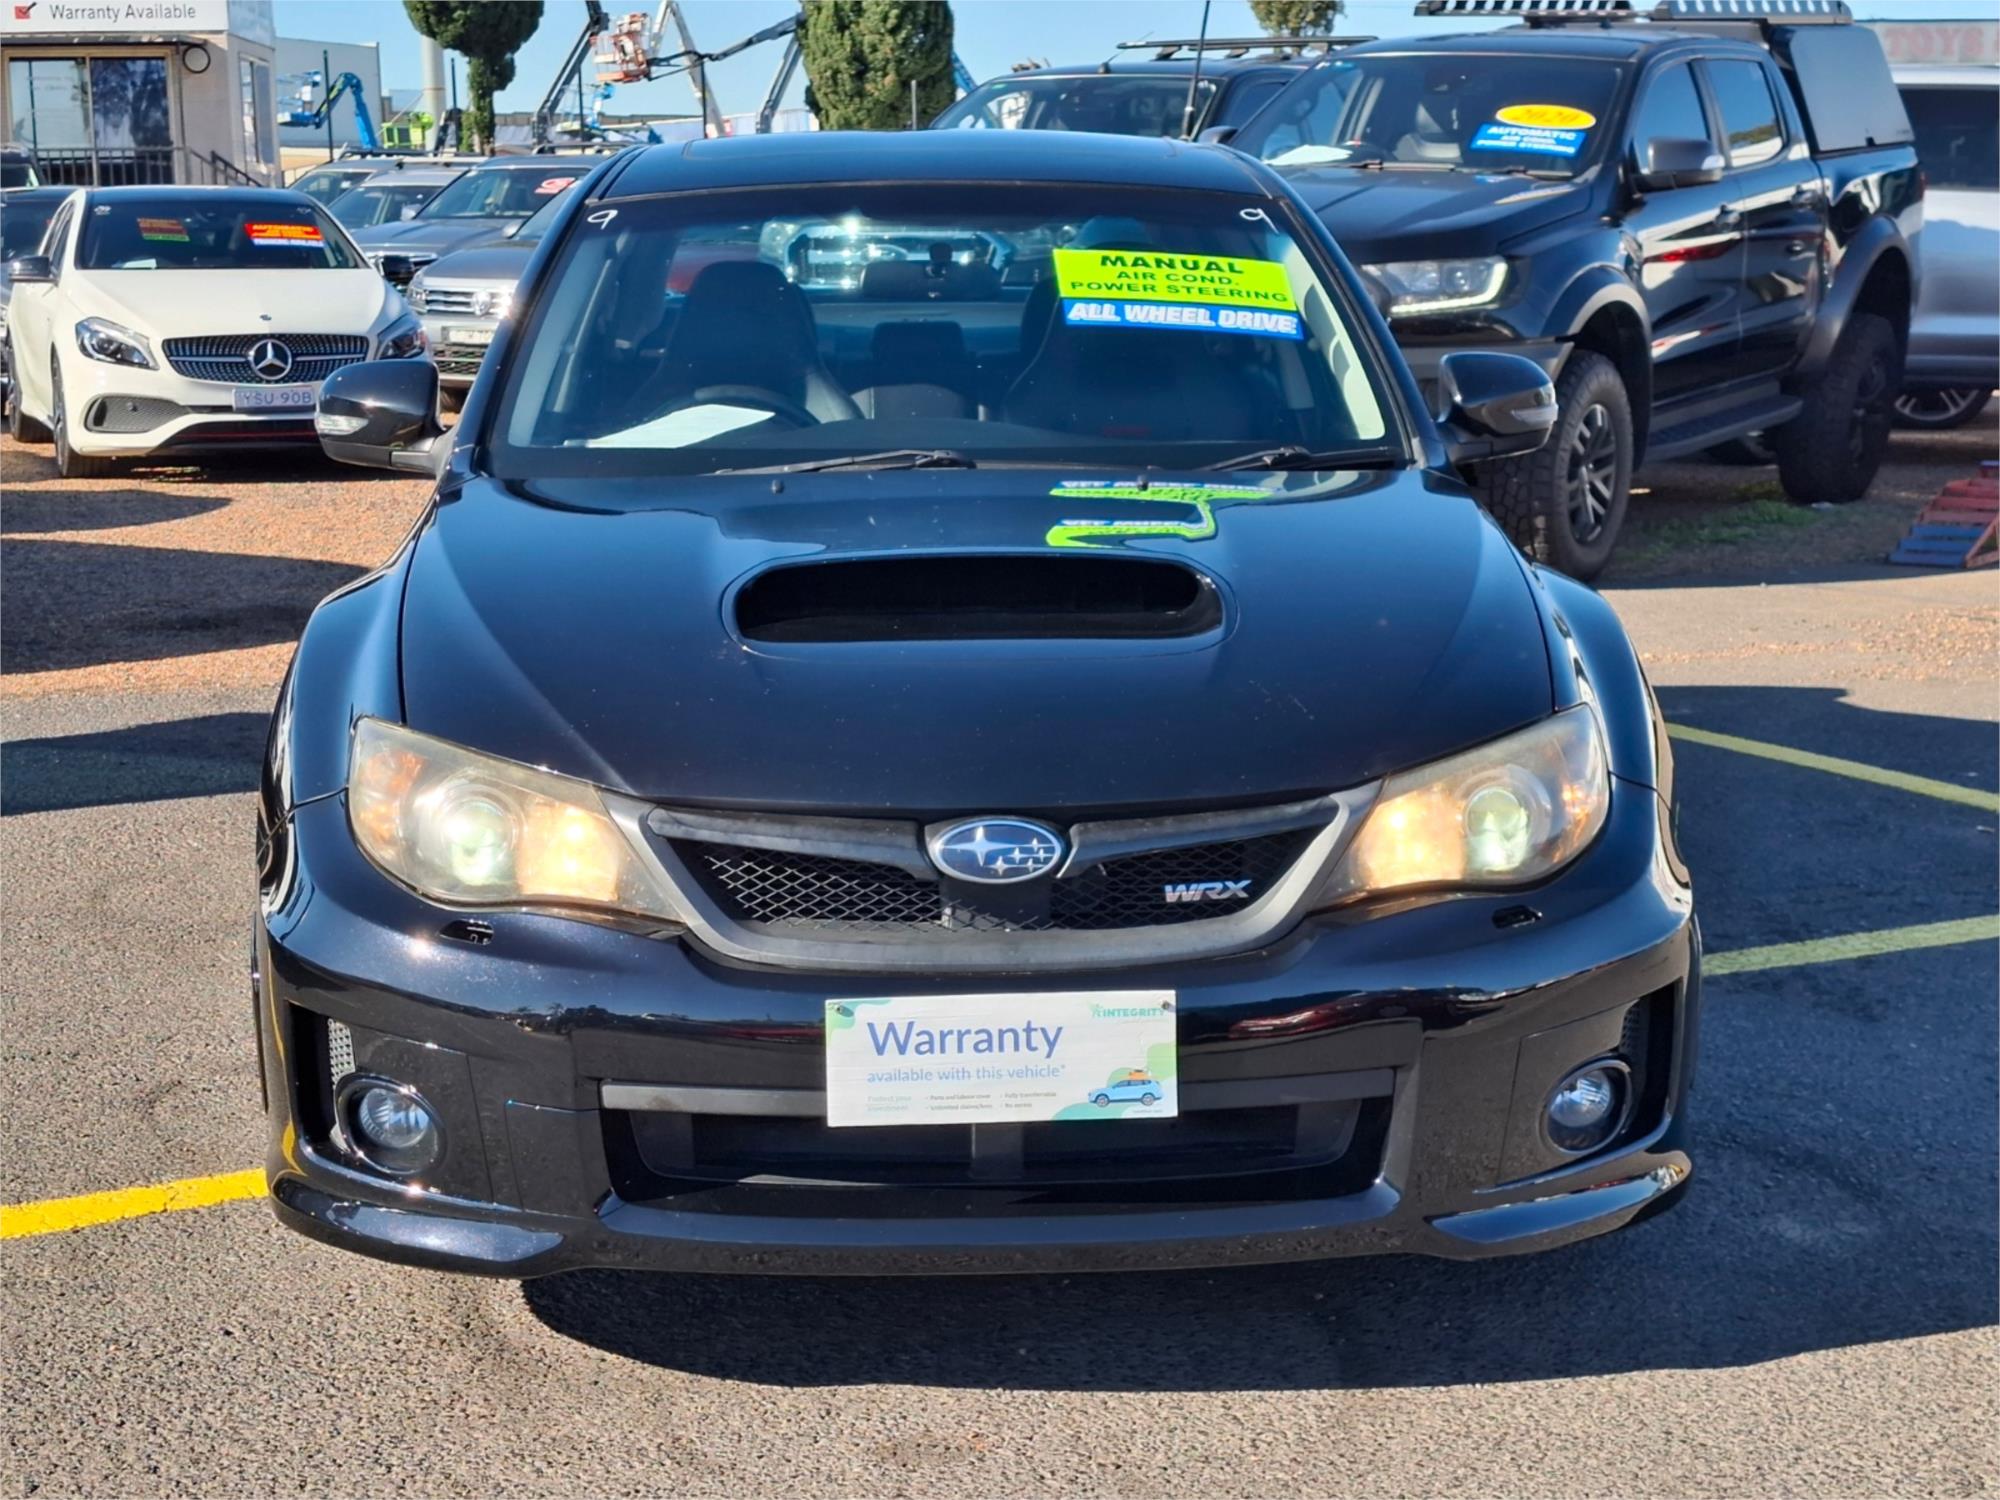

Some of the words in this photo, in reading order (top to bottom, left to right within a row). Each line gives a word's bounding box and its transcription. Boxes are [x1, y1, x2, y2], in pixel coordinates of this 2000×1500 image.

[50, 4, 120, 23] Warranty
[125, 4, 197, 19] Available
[1885, 25, 1985, 58] TOYS
[1486, 126, 1577, 140] AUTOMATIC
[1100, 254, 1245, 275] MANUAL
[1116, 271, 1157, 281] AIR
[1165, 273, 1240, 286] COND.
[1071, 281, 1157, 293] POWER
[1166, 284, 1288, 303] STEERING
[1067, 302, 1121, 322] ALL
[1124, 304, 1216, 327] WHEEL
[1217, 309, 1298, 335] DRIVE
[280, 391, 312, 404] 90B
[1164, 879, 1252, 903] WRX
[866, 1019, 1064, 1059] Warranty
[867, 1068, 933, 1083] available
[937, 1067, 971, 1081] with
[976, 1065, 1003, 1080] this
